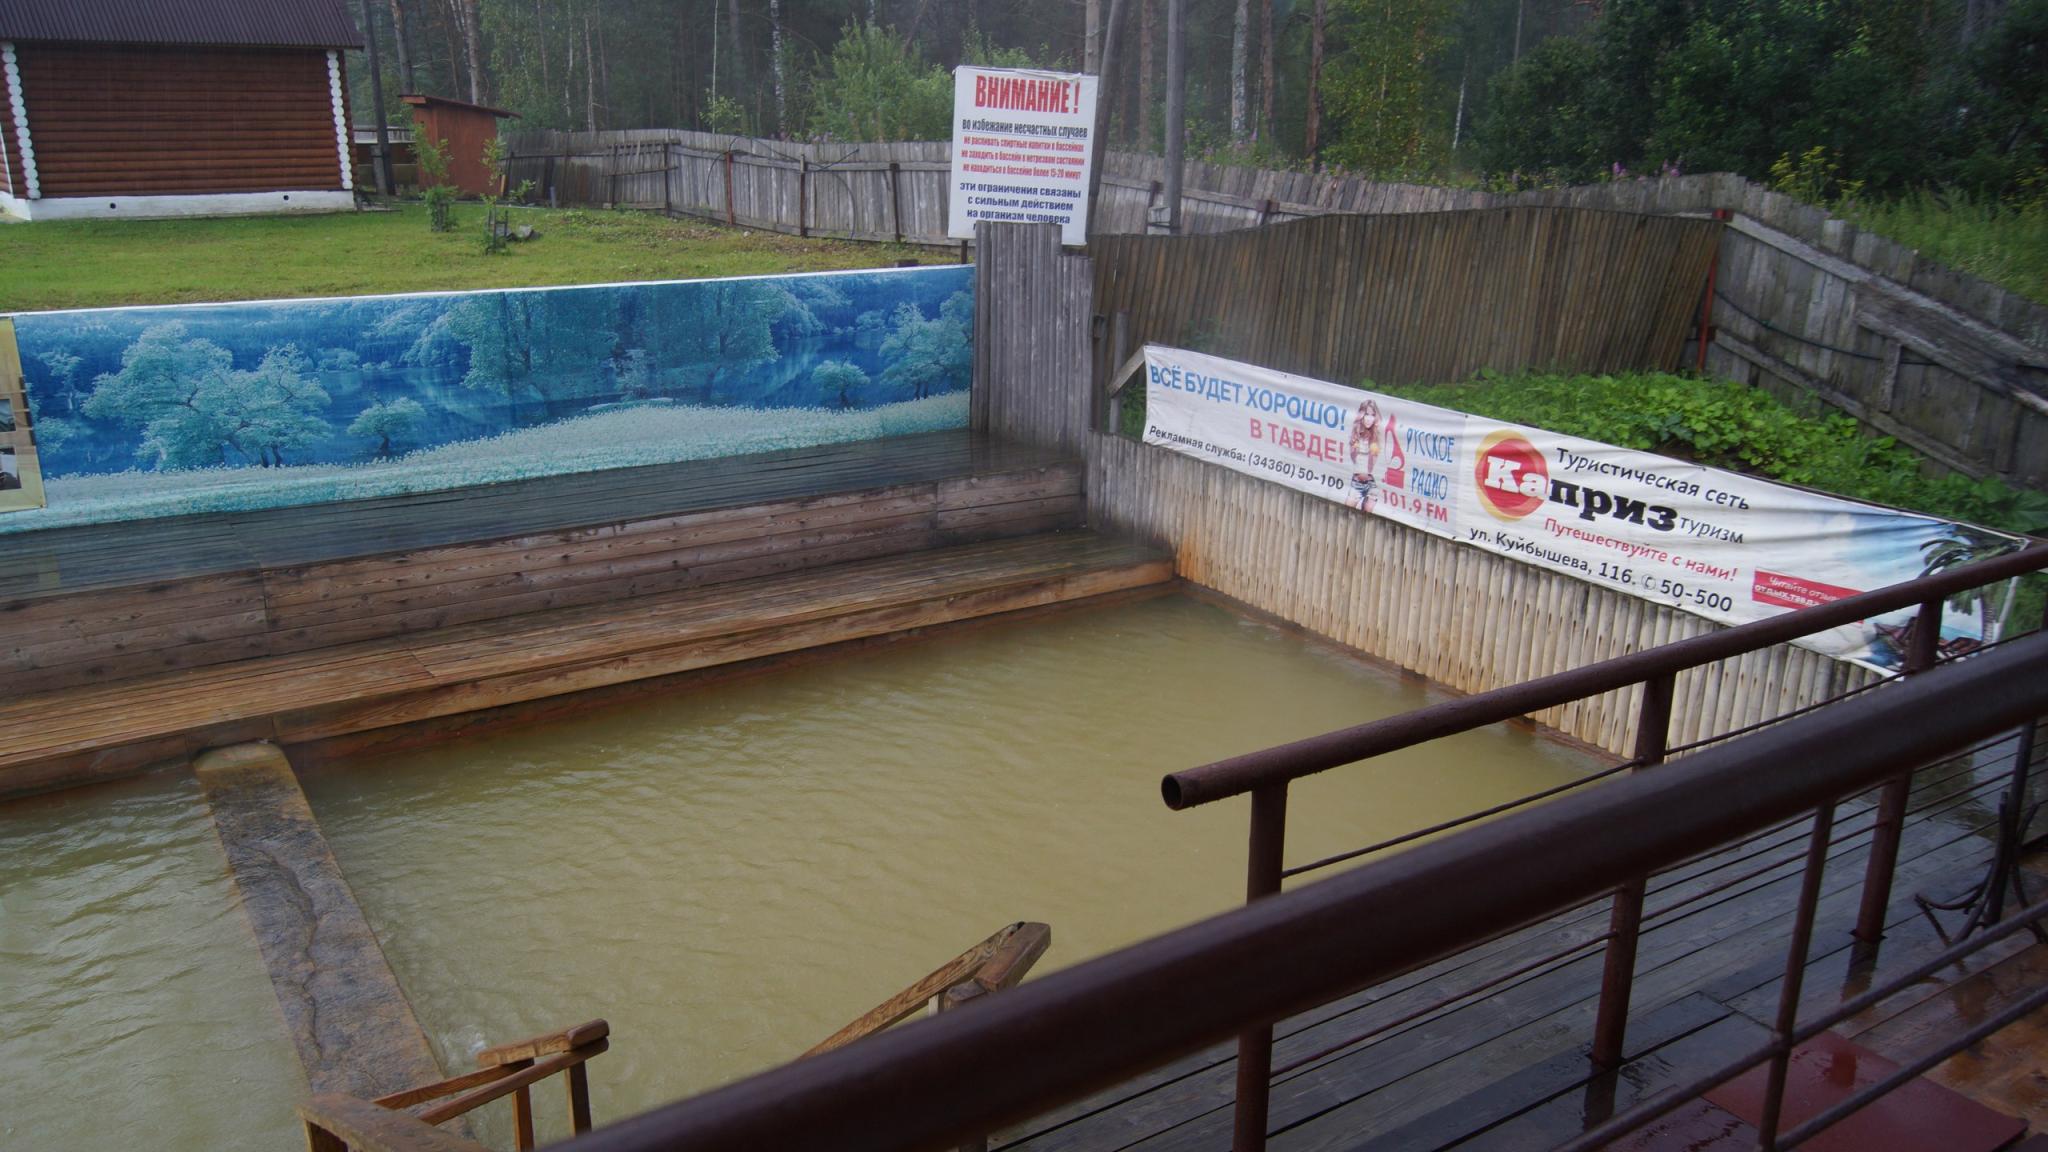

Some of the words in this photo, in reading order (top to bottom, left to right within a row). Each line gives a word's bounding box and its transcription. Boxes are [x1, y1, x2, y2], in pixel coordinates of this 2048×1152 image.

[975, 75, 1071, 113] ВНИМАНИЕ
[962, 119, 970, 129] во
[972, 119, 1013, 133] избежание
[1014, 122, 1057, 136] несчастных
[1058, 126, 1088, 138] случаев
[963, 136, 971, 144] не
[971, 137, 1000, 147] распивать
[1000, 138, 1027, 149] спиртные
[1028, 140, 1051, 150] напитки
[1055, 142, 1084, 152] бассейнах
[961, 150, 969, 158] не
[969, 151, 994, 160] заходить
[999, 152, 1021, 162] бассейн
[1026, 155, 1056, 164] нетрезвом
[1056, 157, 1085, 165] состоянии
[970, 165, 1002, 174] находиться
[1006, 165, 1032, 176] бассейне
[1033, 167, 1049, 177] более
[1050, 168, 1064, 178] 15-20
[1065, 170, 1081, 180] минут
[959, 182, 976, 191] эти
[978, 183, 1038, 196] ограничения
[1039, 188, 1081, 199] связаны
[975, 197, 1019, 207] сильным
[1021, 199, 1074, 211] действием
[967, 209, 978, 218] на
[979, 211, 1025, 222] организм
[1026, 214, 1070, 225] человека
[1150, 363, 1182, 390] ВСЁ
[1185, 372, 1243, 404] БУДЕТ
[1245, 386, 1347, 431] ХОРОШО!
[1250, 418, 1262, 439] В
[1267, 423, 1344, 463] ТАВДЕ!
[1406, 428, 1456, 463] РУССКОЕ
[1148, 425, 1204, 450] Рекламная
[1204, 441, 1247, 463] служба:
[1248, 451, 1296, 479] (34360)
[1297, 467, 1344, 491] 50-100
[1411, 467, 1449, 501] РАДИО
[1484, 456, 1678, 532] Каприз
[1555, 447, 1700, 497] Туристическая
[1704, 487, 1750, 511] сеть
[1382, 489, 1422, 514] 101.9
[1426, 502, 1448, 522] FM
[1680, 517, 1744, 545] туризм
[1544, 518, 1668, 563] Путешествуйте
[1671, 554, 1682, 566] с
[1685, 560, 1739, 582] нами!
[1469, 527, 1491, 542] ул.
[1495, 531, 1593, 576] Куйбышева,
[1599, 562, 1637, 586] 116.
[1660, 579, 1733, 612] 50-500
[1769, 576, 1808, 594] Читайте
